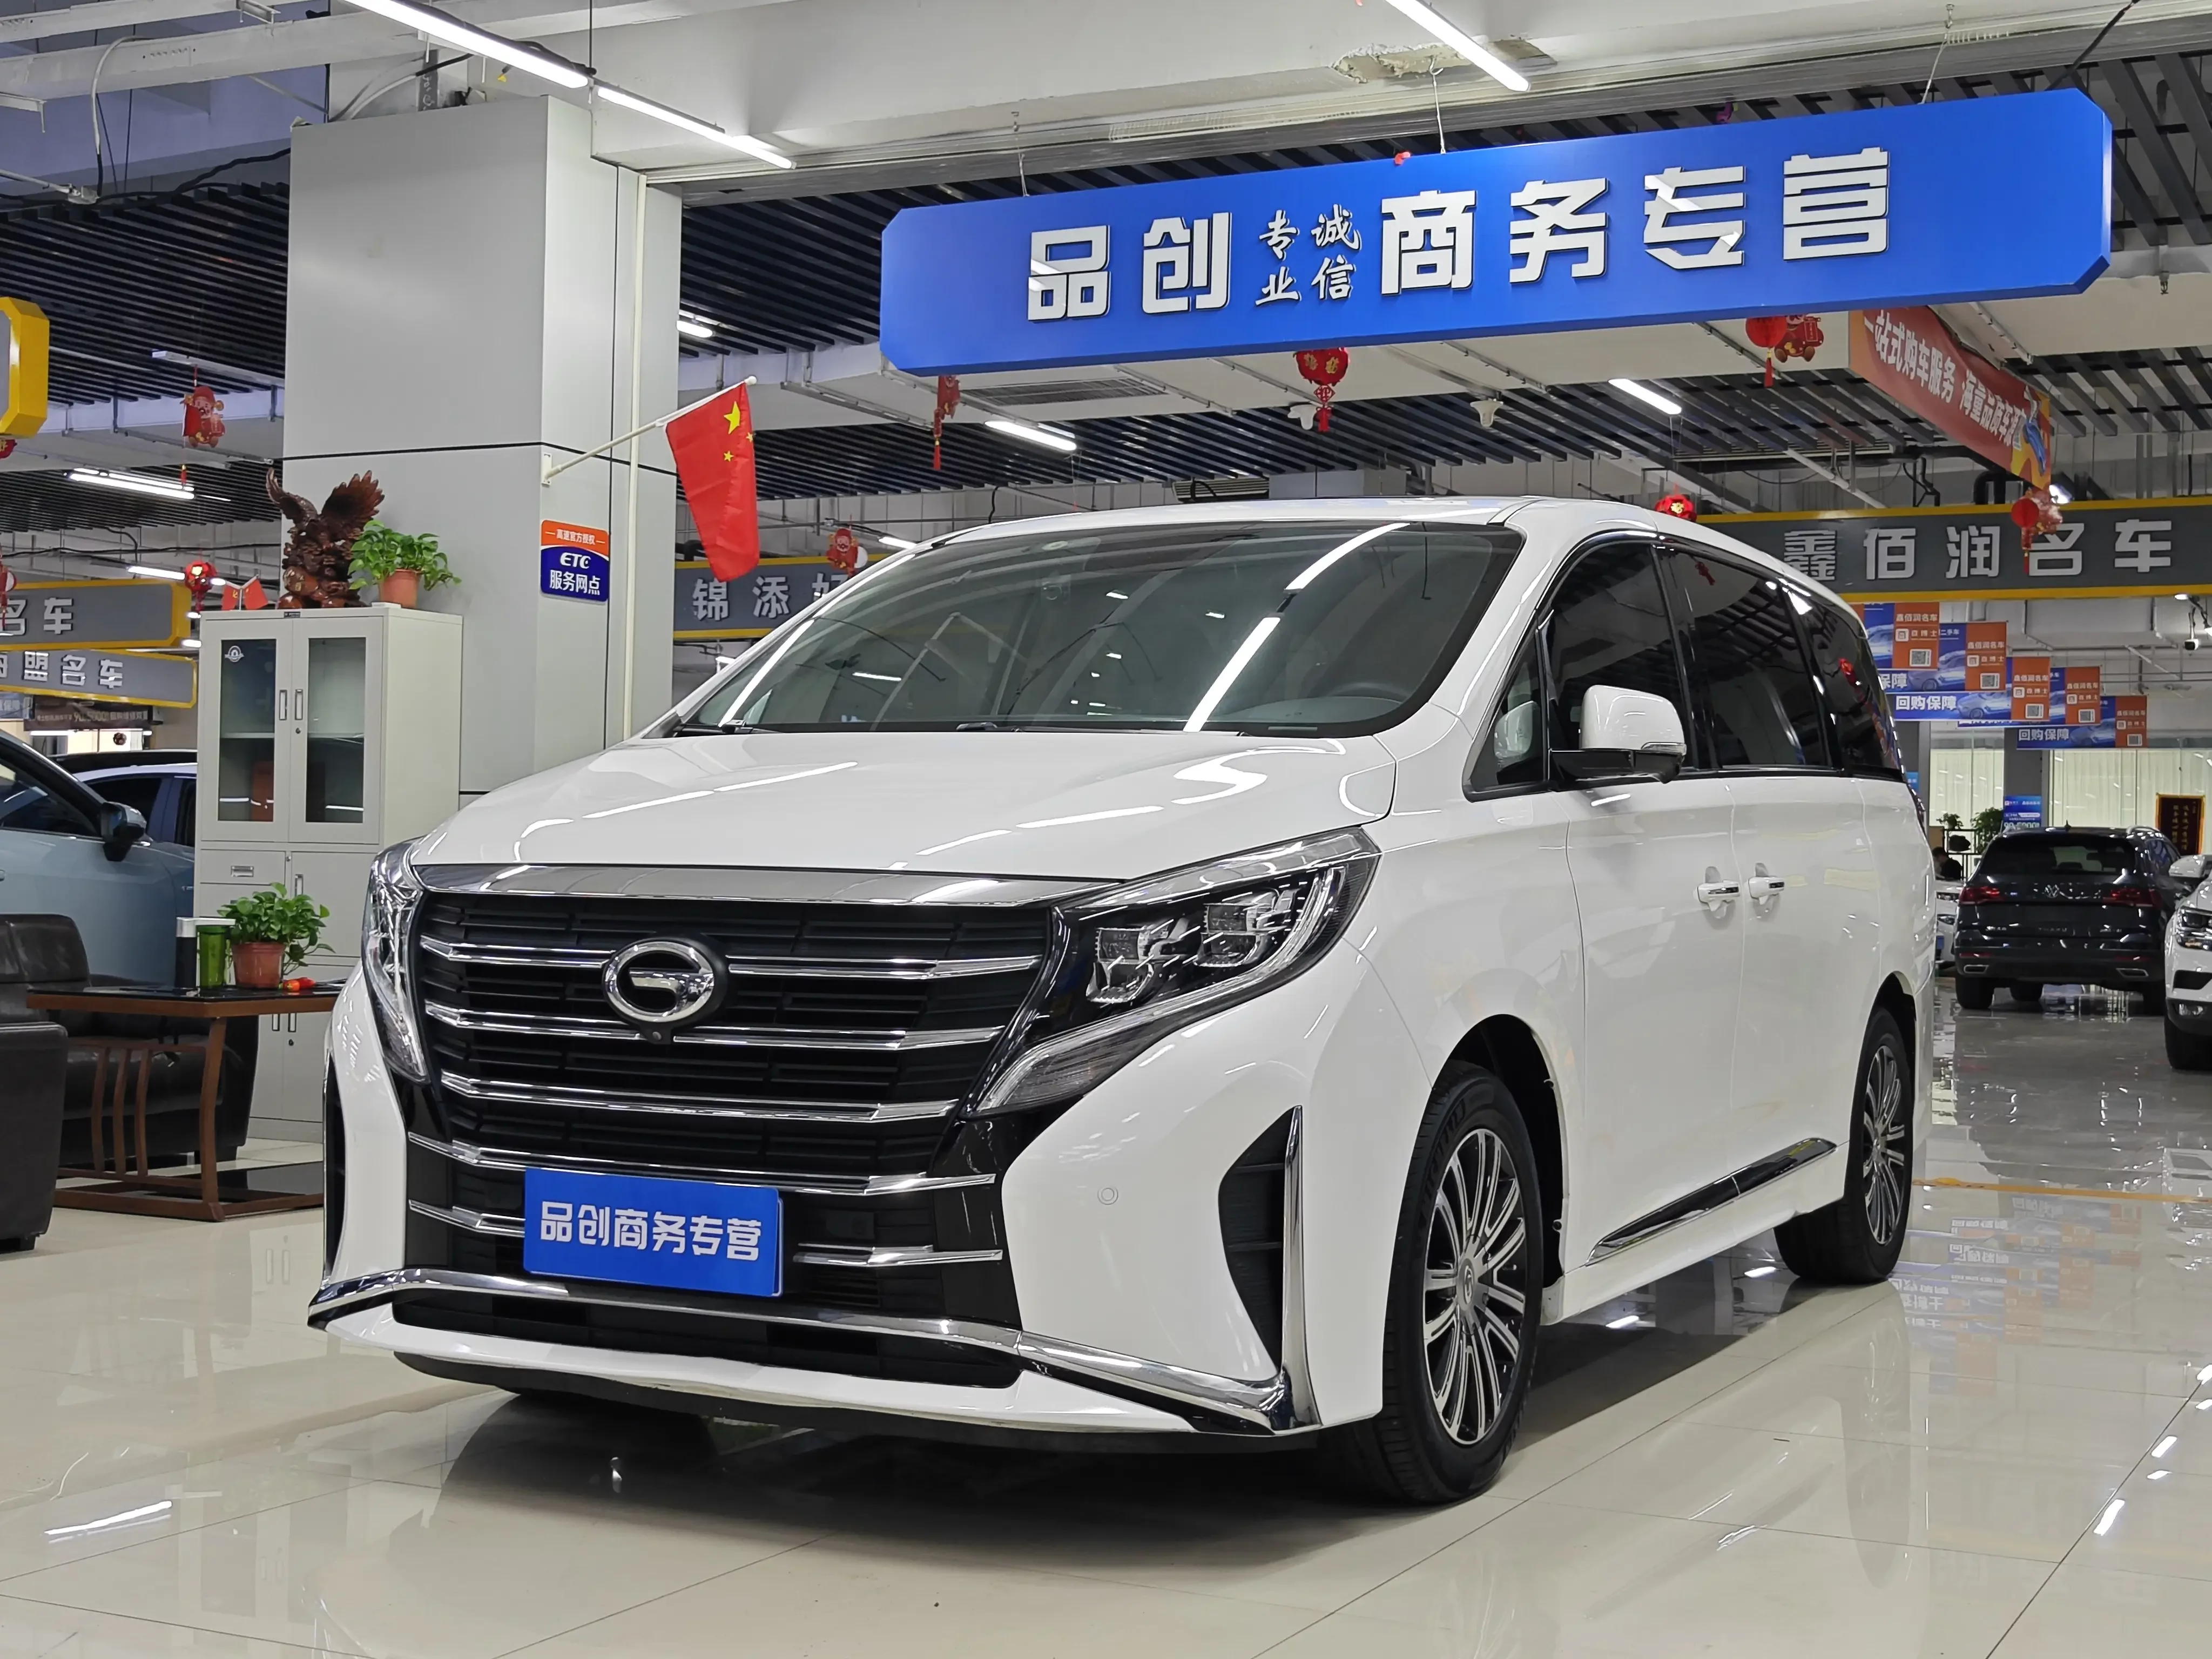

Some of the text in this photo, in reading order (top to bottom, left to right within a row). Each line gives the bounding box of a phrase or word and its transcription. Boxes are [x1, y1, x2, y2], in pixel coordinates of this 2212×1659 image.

[1028, 147, 1890, 322] 品创 商务专营
[1255, 209, 1300, 306] 专业
[1311, 204, 1361, 300] 诚信
[1864, 309, 1956, 403] 一站式购车服务
[560, 552, 591, 569] ETC
[1784, 519, 2172, 581] 鑫佰润名车
[550, 569, 601, 595] 服务网点
[0, 597, 73, 635] 名车
[0, 649, 123, 689] 盟名车
[1895, 695, 1957, 711] 回购保障
[2018, 729, 2069, 741] 回购保障
[541, 1201, 761, 1261] 品创商务专营
